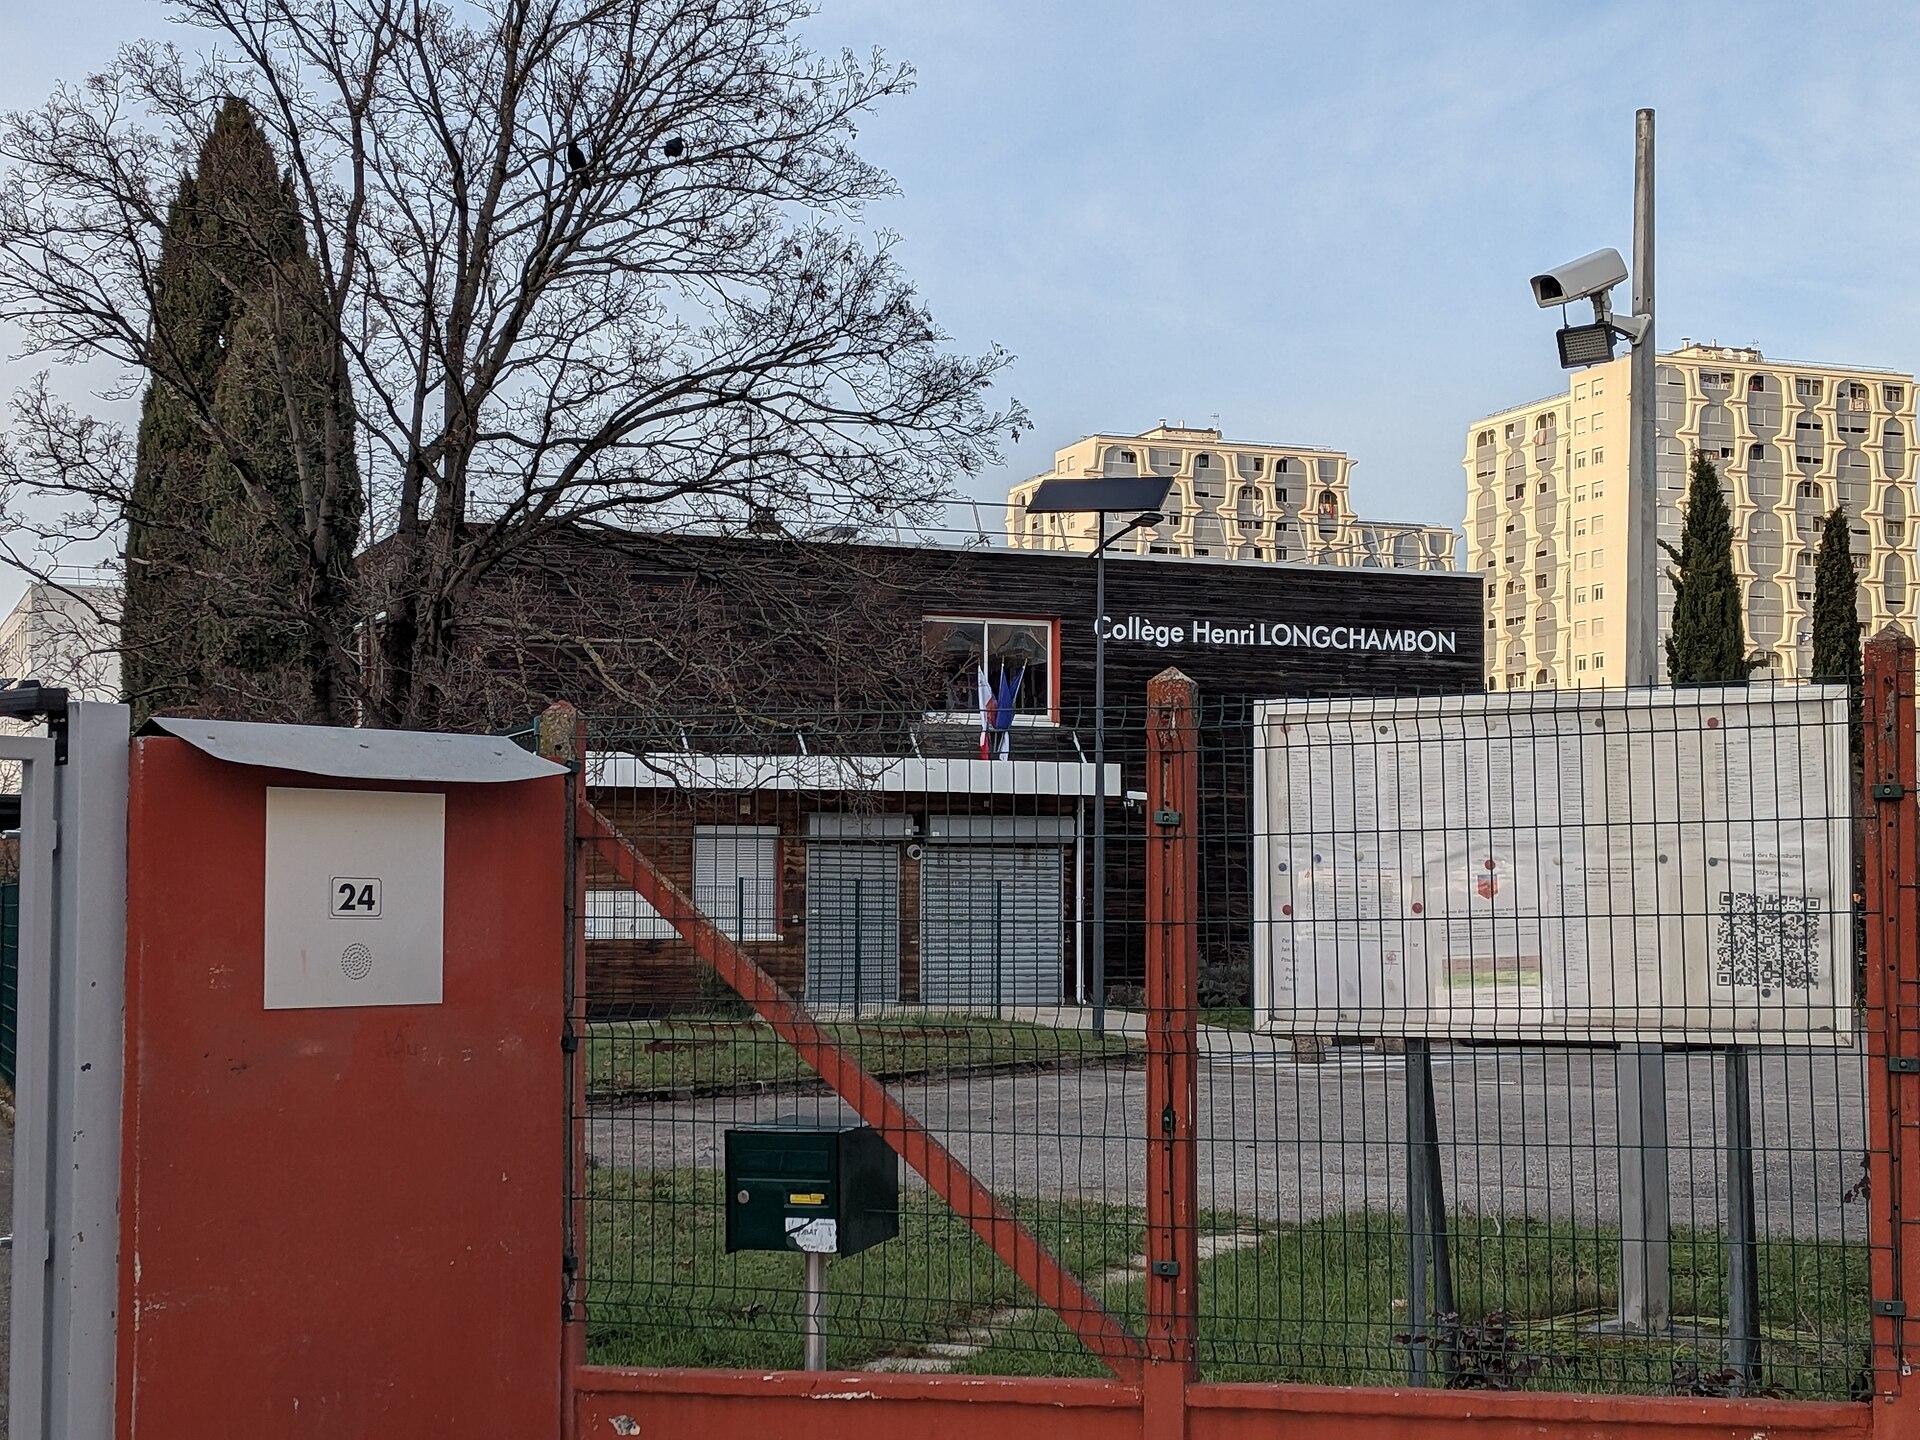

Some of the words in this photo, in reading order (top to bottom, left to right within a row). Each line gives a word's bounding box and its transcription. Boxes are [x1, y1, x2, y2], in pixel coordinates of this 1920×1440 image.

[1094, 615, 1184, 648] Collège
[1193, 620, 1255, 645] Henri
[1260, 623, 1456, 653] LONGCHAMBON
[338, 883, 376, 911] 24
